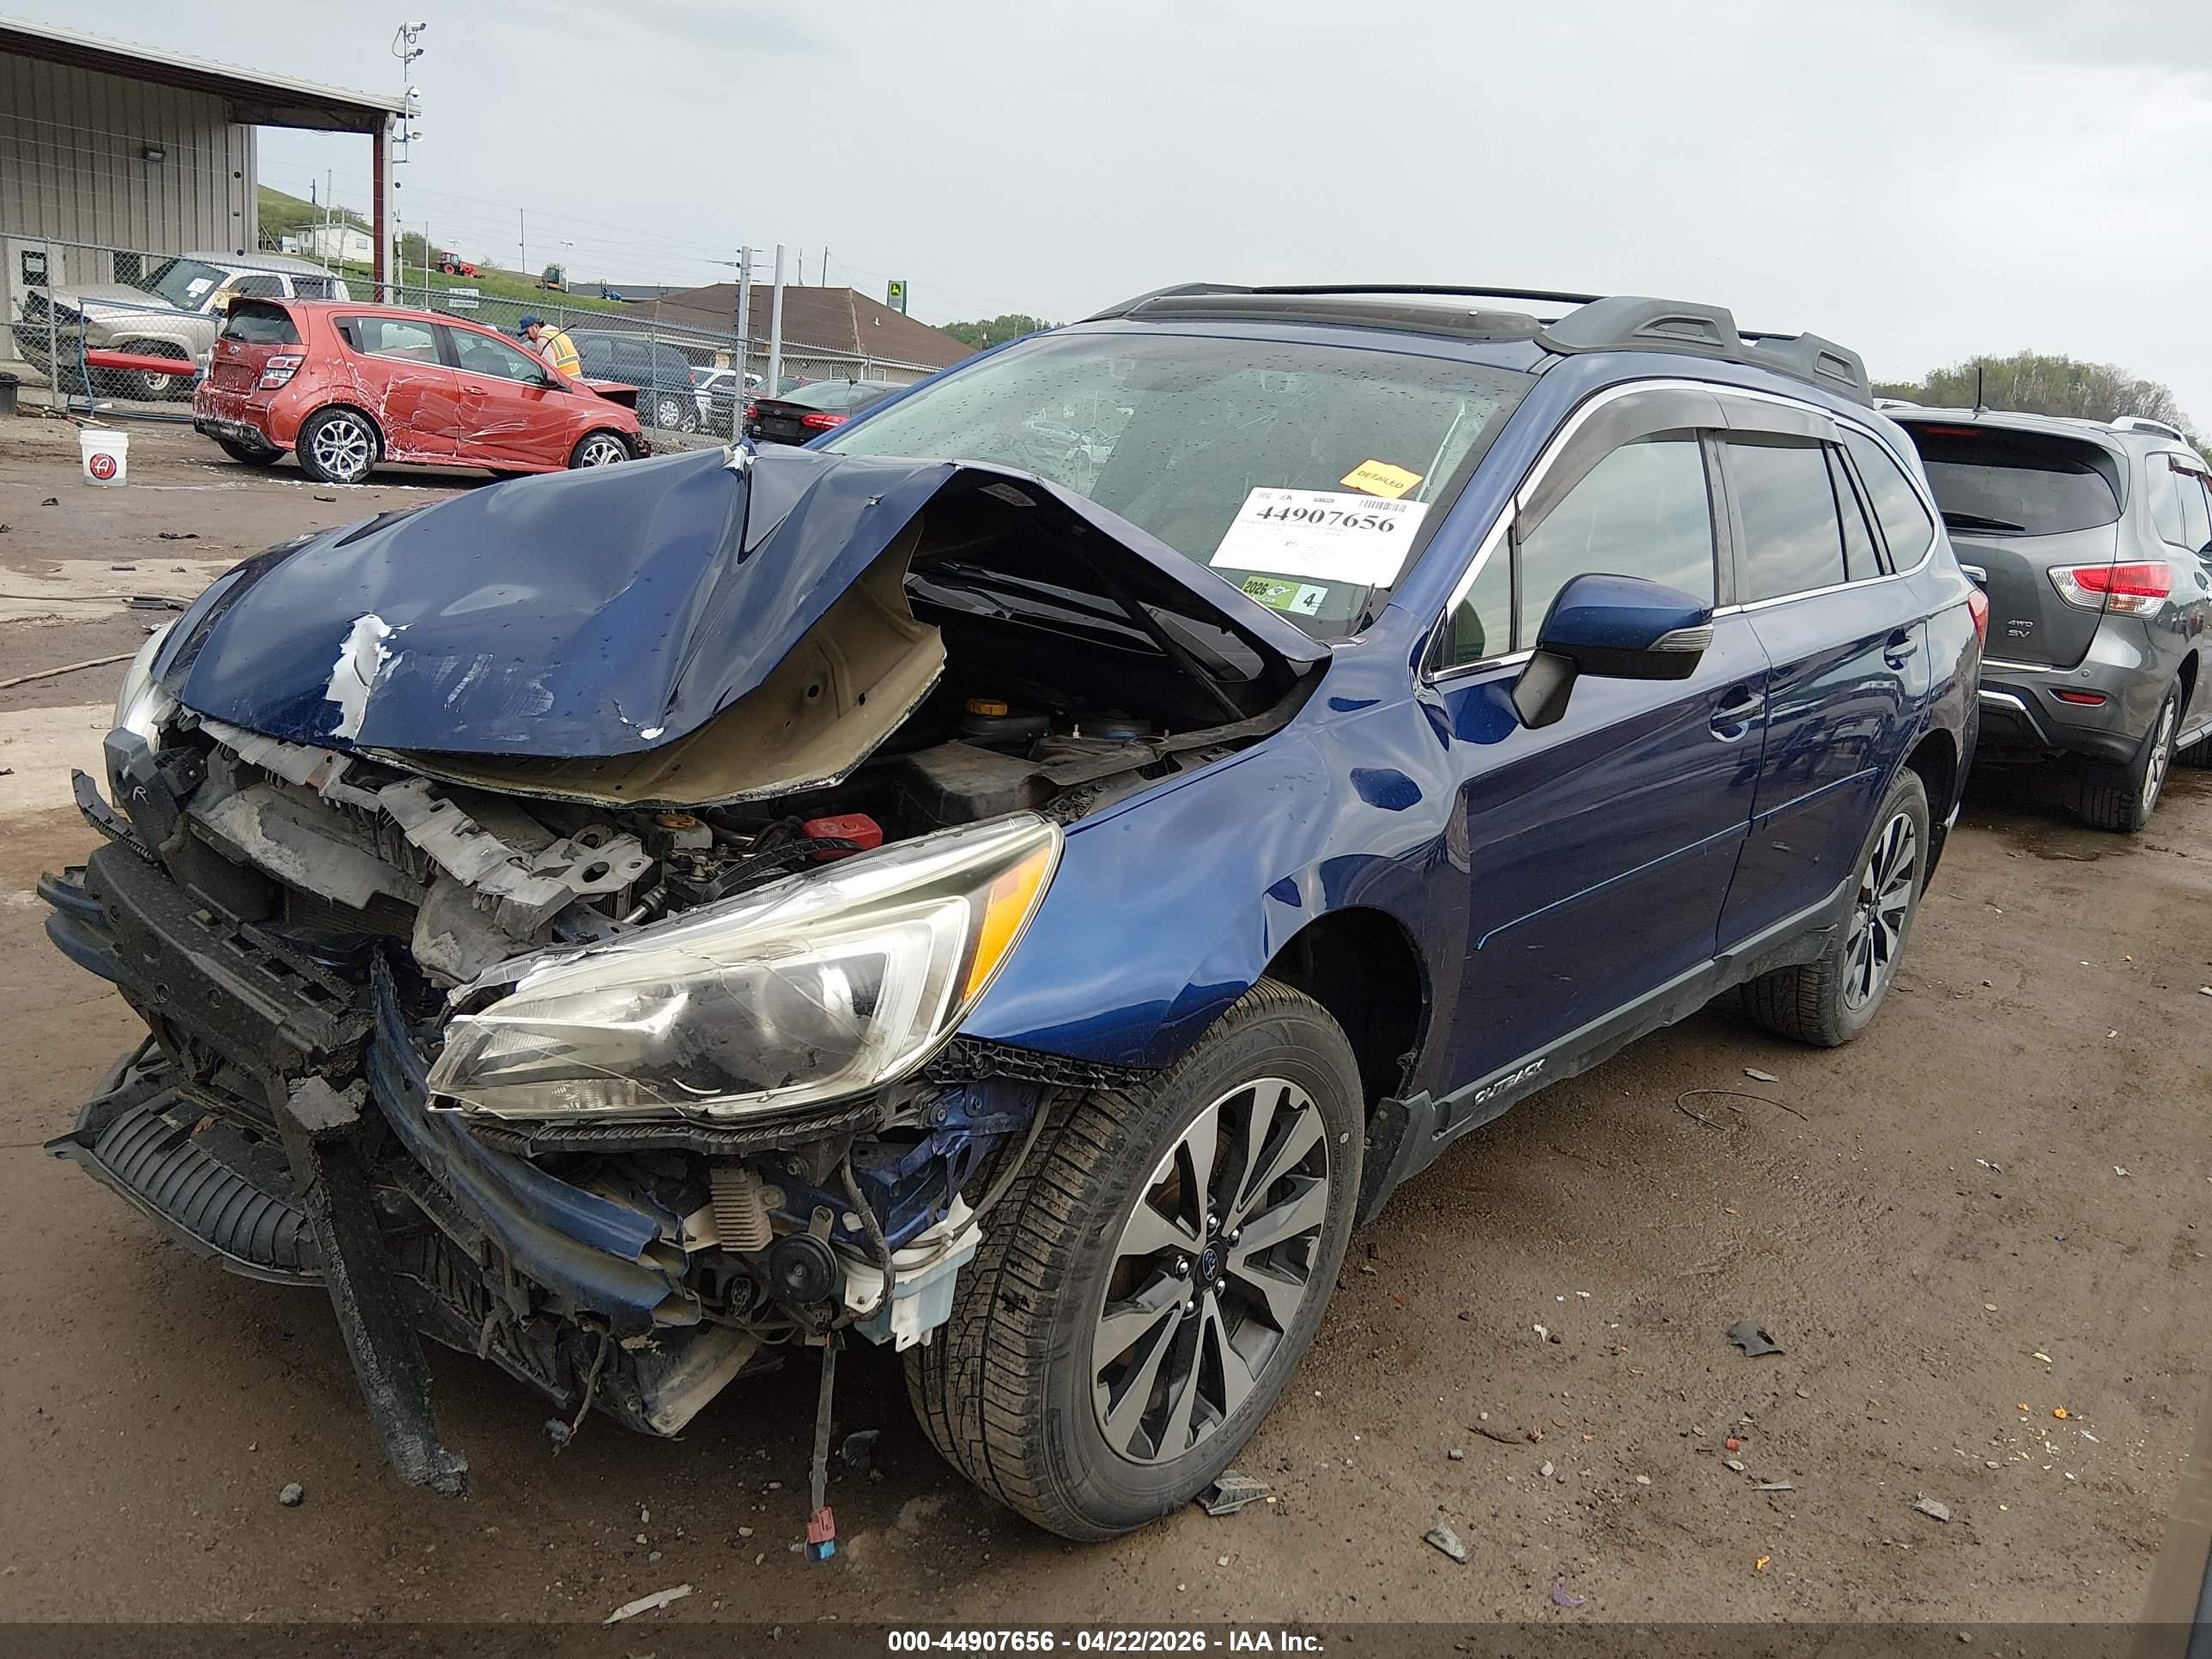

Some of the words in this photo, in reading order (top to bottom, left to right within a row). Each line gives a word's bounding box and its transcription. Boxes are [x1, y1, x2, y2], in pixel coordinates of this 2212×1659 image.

[1256, 505, 1396, 532] 44907656
[1243, 580, 1269, 595] 2026
[1303, 592, 1316, 607] 4
[2007, 629, 2031, 638] SV
